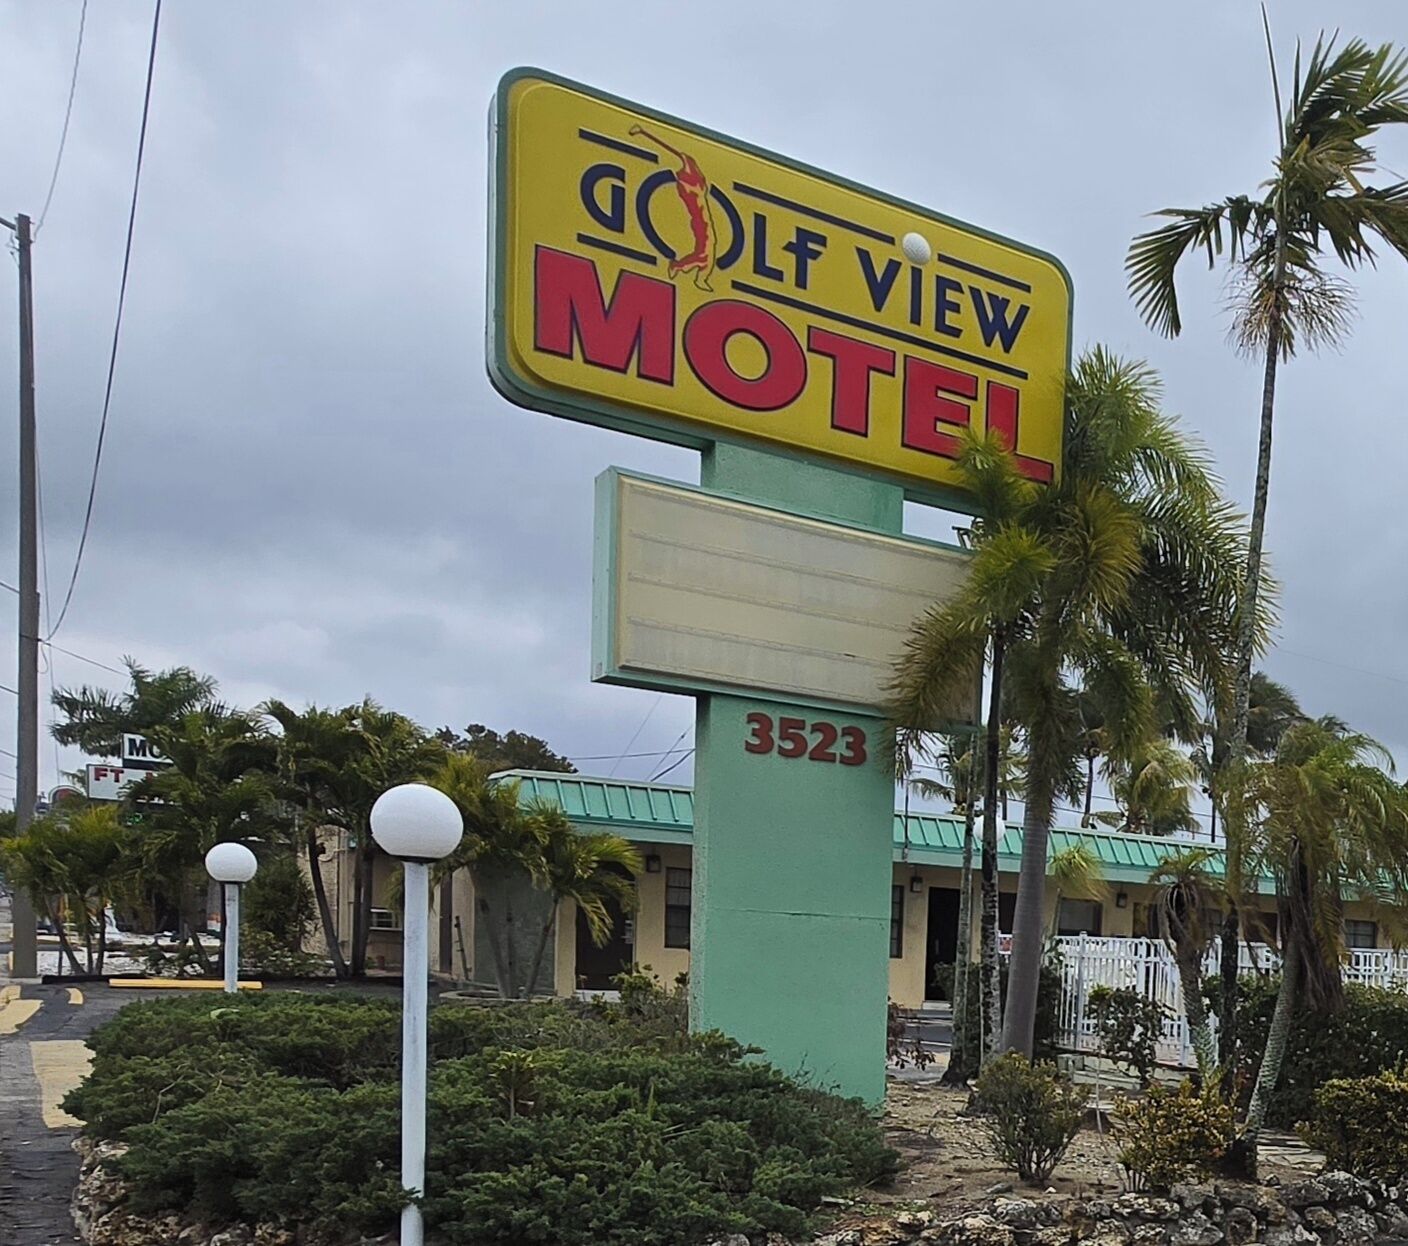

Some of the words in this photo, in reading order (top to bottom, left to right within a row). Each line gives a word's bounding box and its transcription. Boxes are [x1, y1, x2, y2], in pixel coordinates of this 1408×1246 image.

[579, 162, 827, 290] GOLF
[855, 246, 1031, 354] VIEW
[533, 243, 1055, 486] MOTEL
[94, 766, 124, 783] FT
[744, 711, 867, 766] 3523
